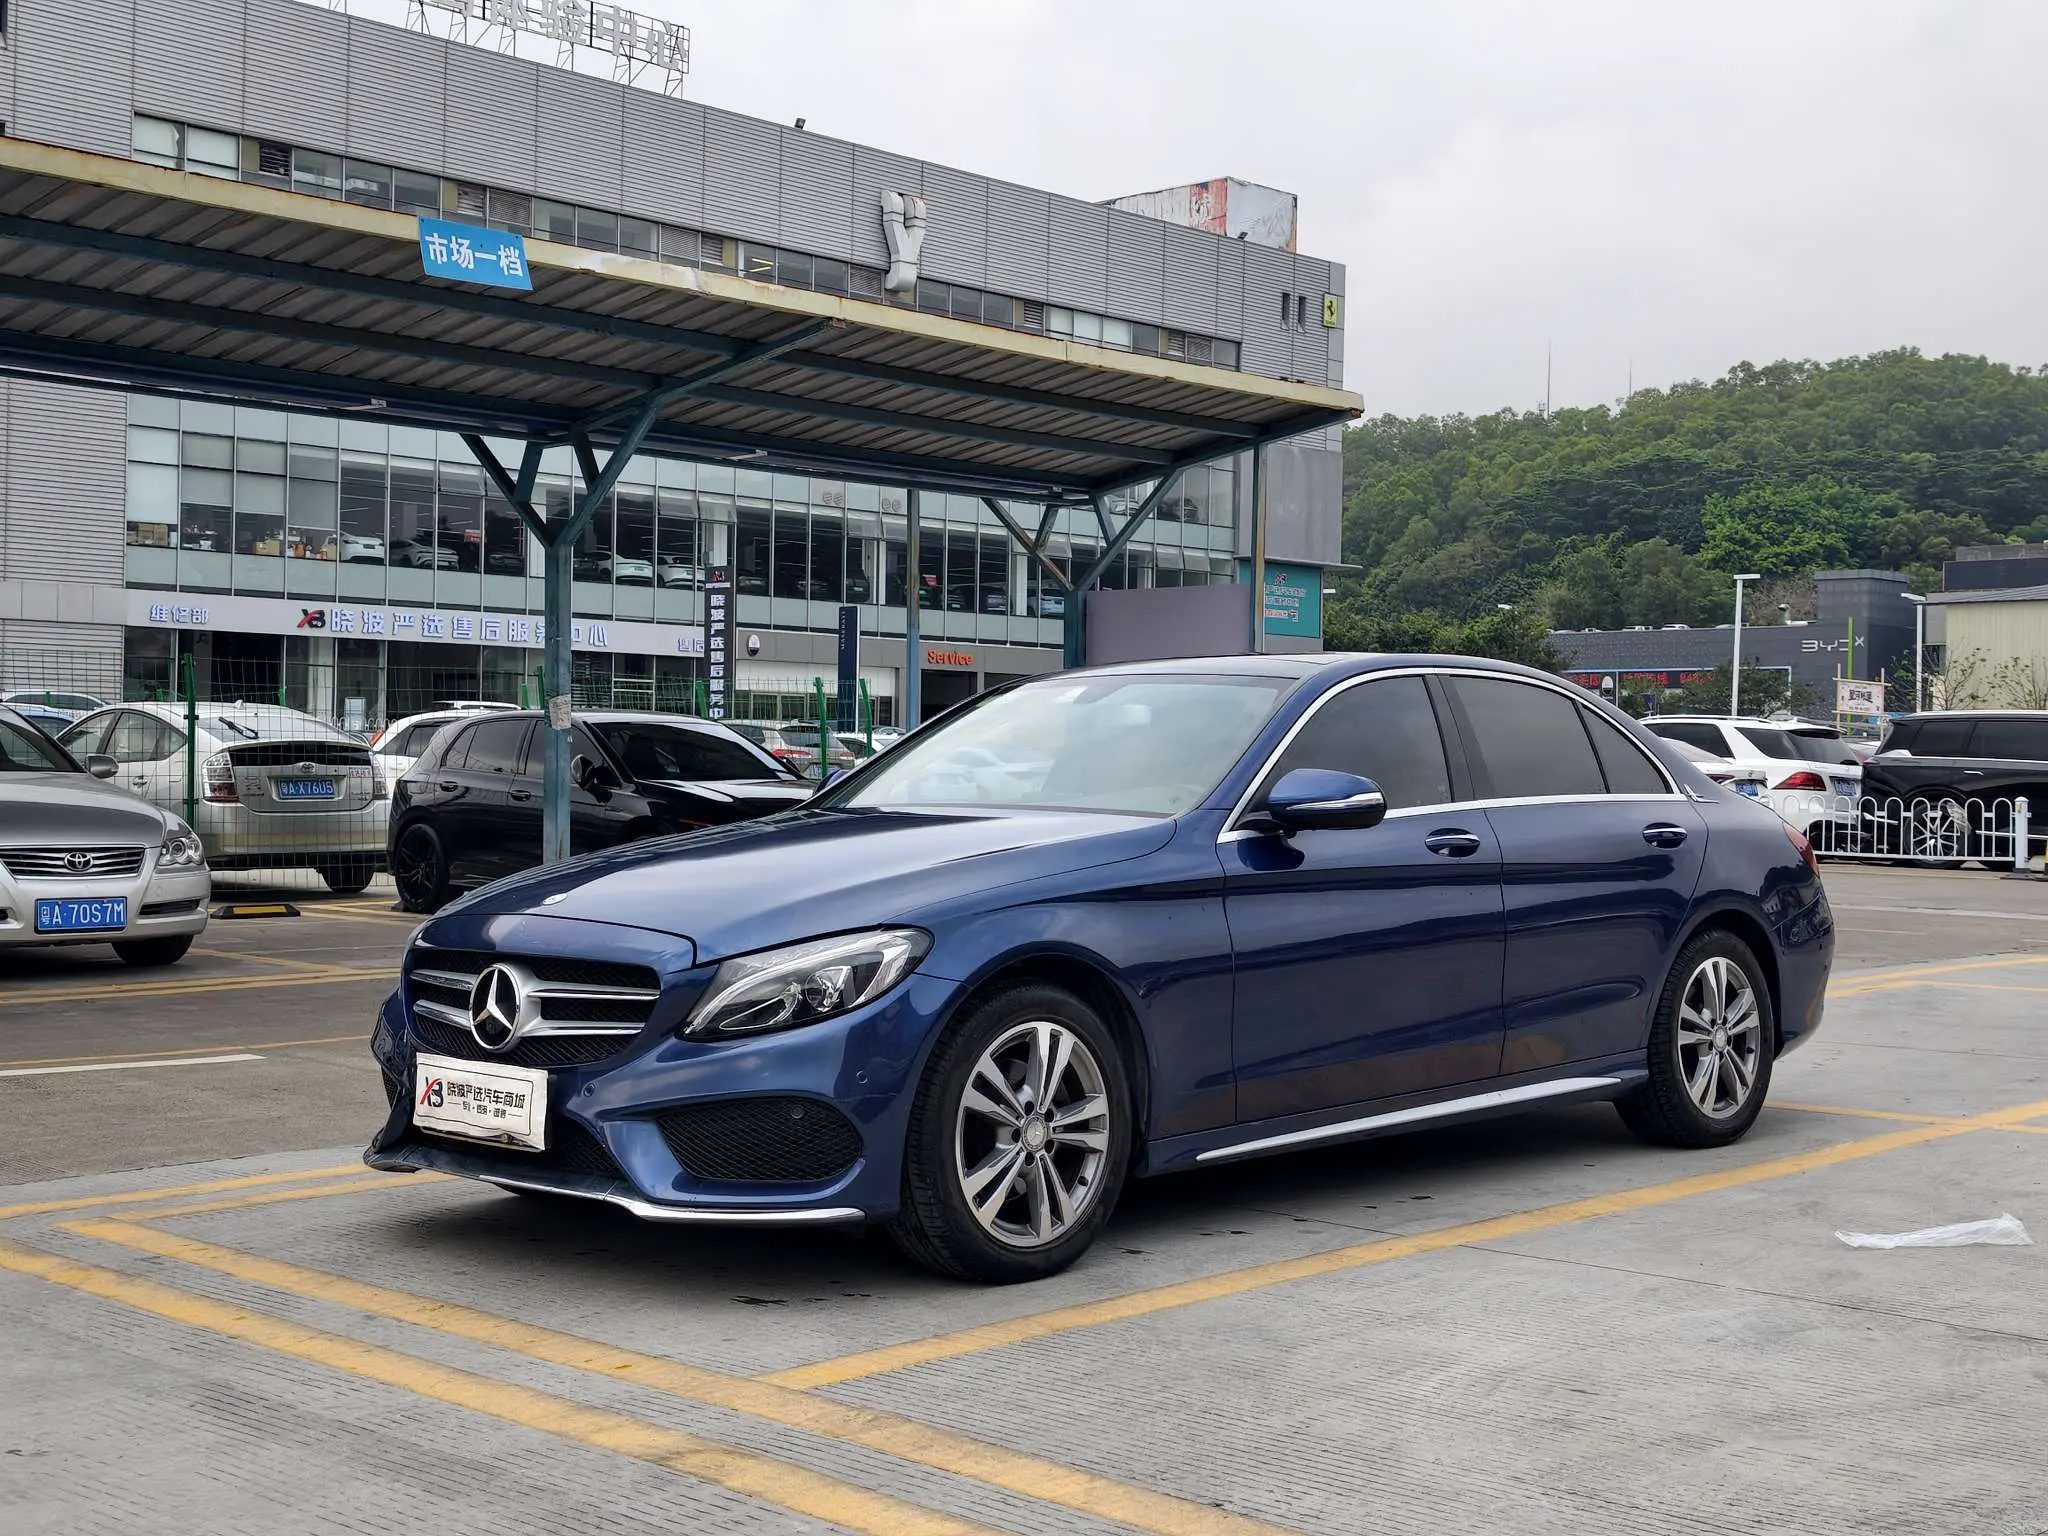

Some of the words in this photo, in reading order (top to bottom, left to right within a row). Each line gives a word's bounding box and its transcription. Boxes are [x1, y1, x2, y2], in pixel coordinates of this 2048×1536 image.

[425, 233, 523, 276] 市场一档
[150, 604, 208, 624] 维修部
[927, 648, 974, 666] Service
[41, 902, 124, 925] 粤A·70S7M
[447, 1081, 526, 1109] 晓波严选汽车商城
